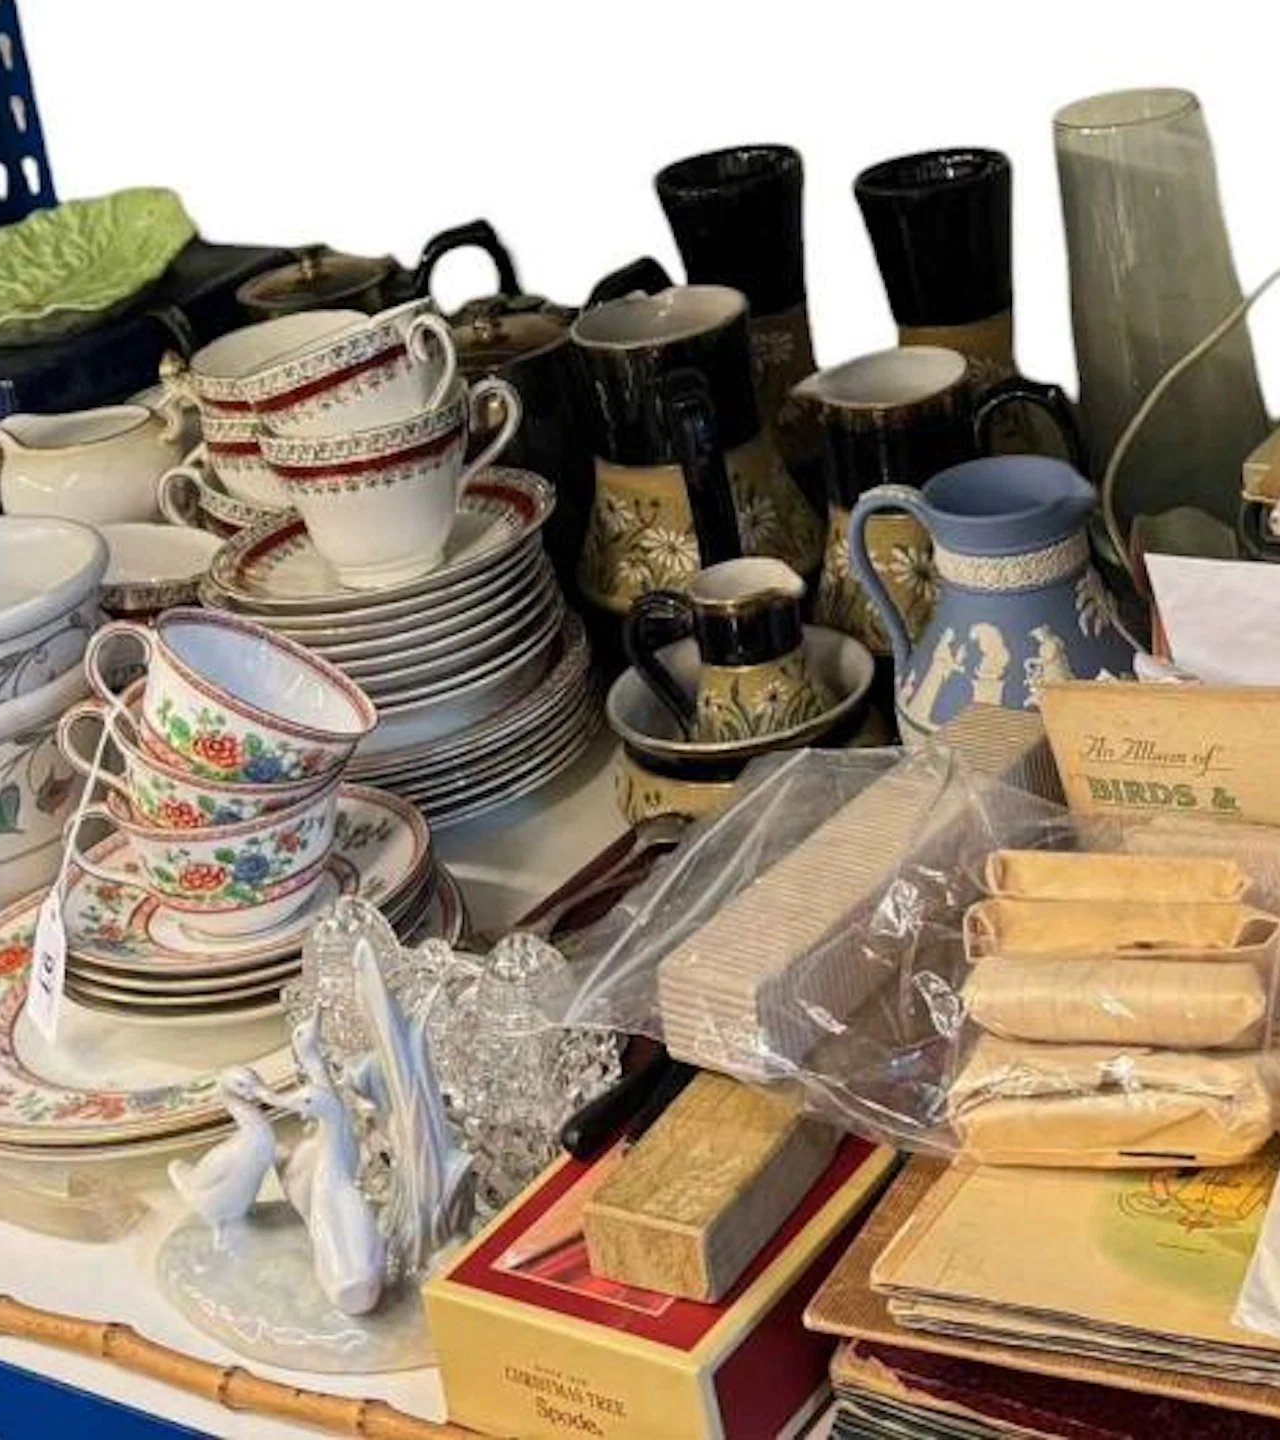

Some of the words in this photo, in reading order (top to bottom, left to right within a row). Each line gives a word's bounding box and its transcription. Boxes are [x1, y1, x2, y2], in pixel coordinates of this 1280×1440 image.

[1084, 734, 1115, 759] An
[1122, 737, 1186, 763] Album
[1192, 743, 1222, 777] of
[1087, 776, 1197, 806] BIRDS
[1211, 786, 1237, 809] &
